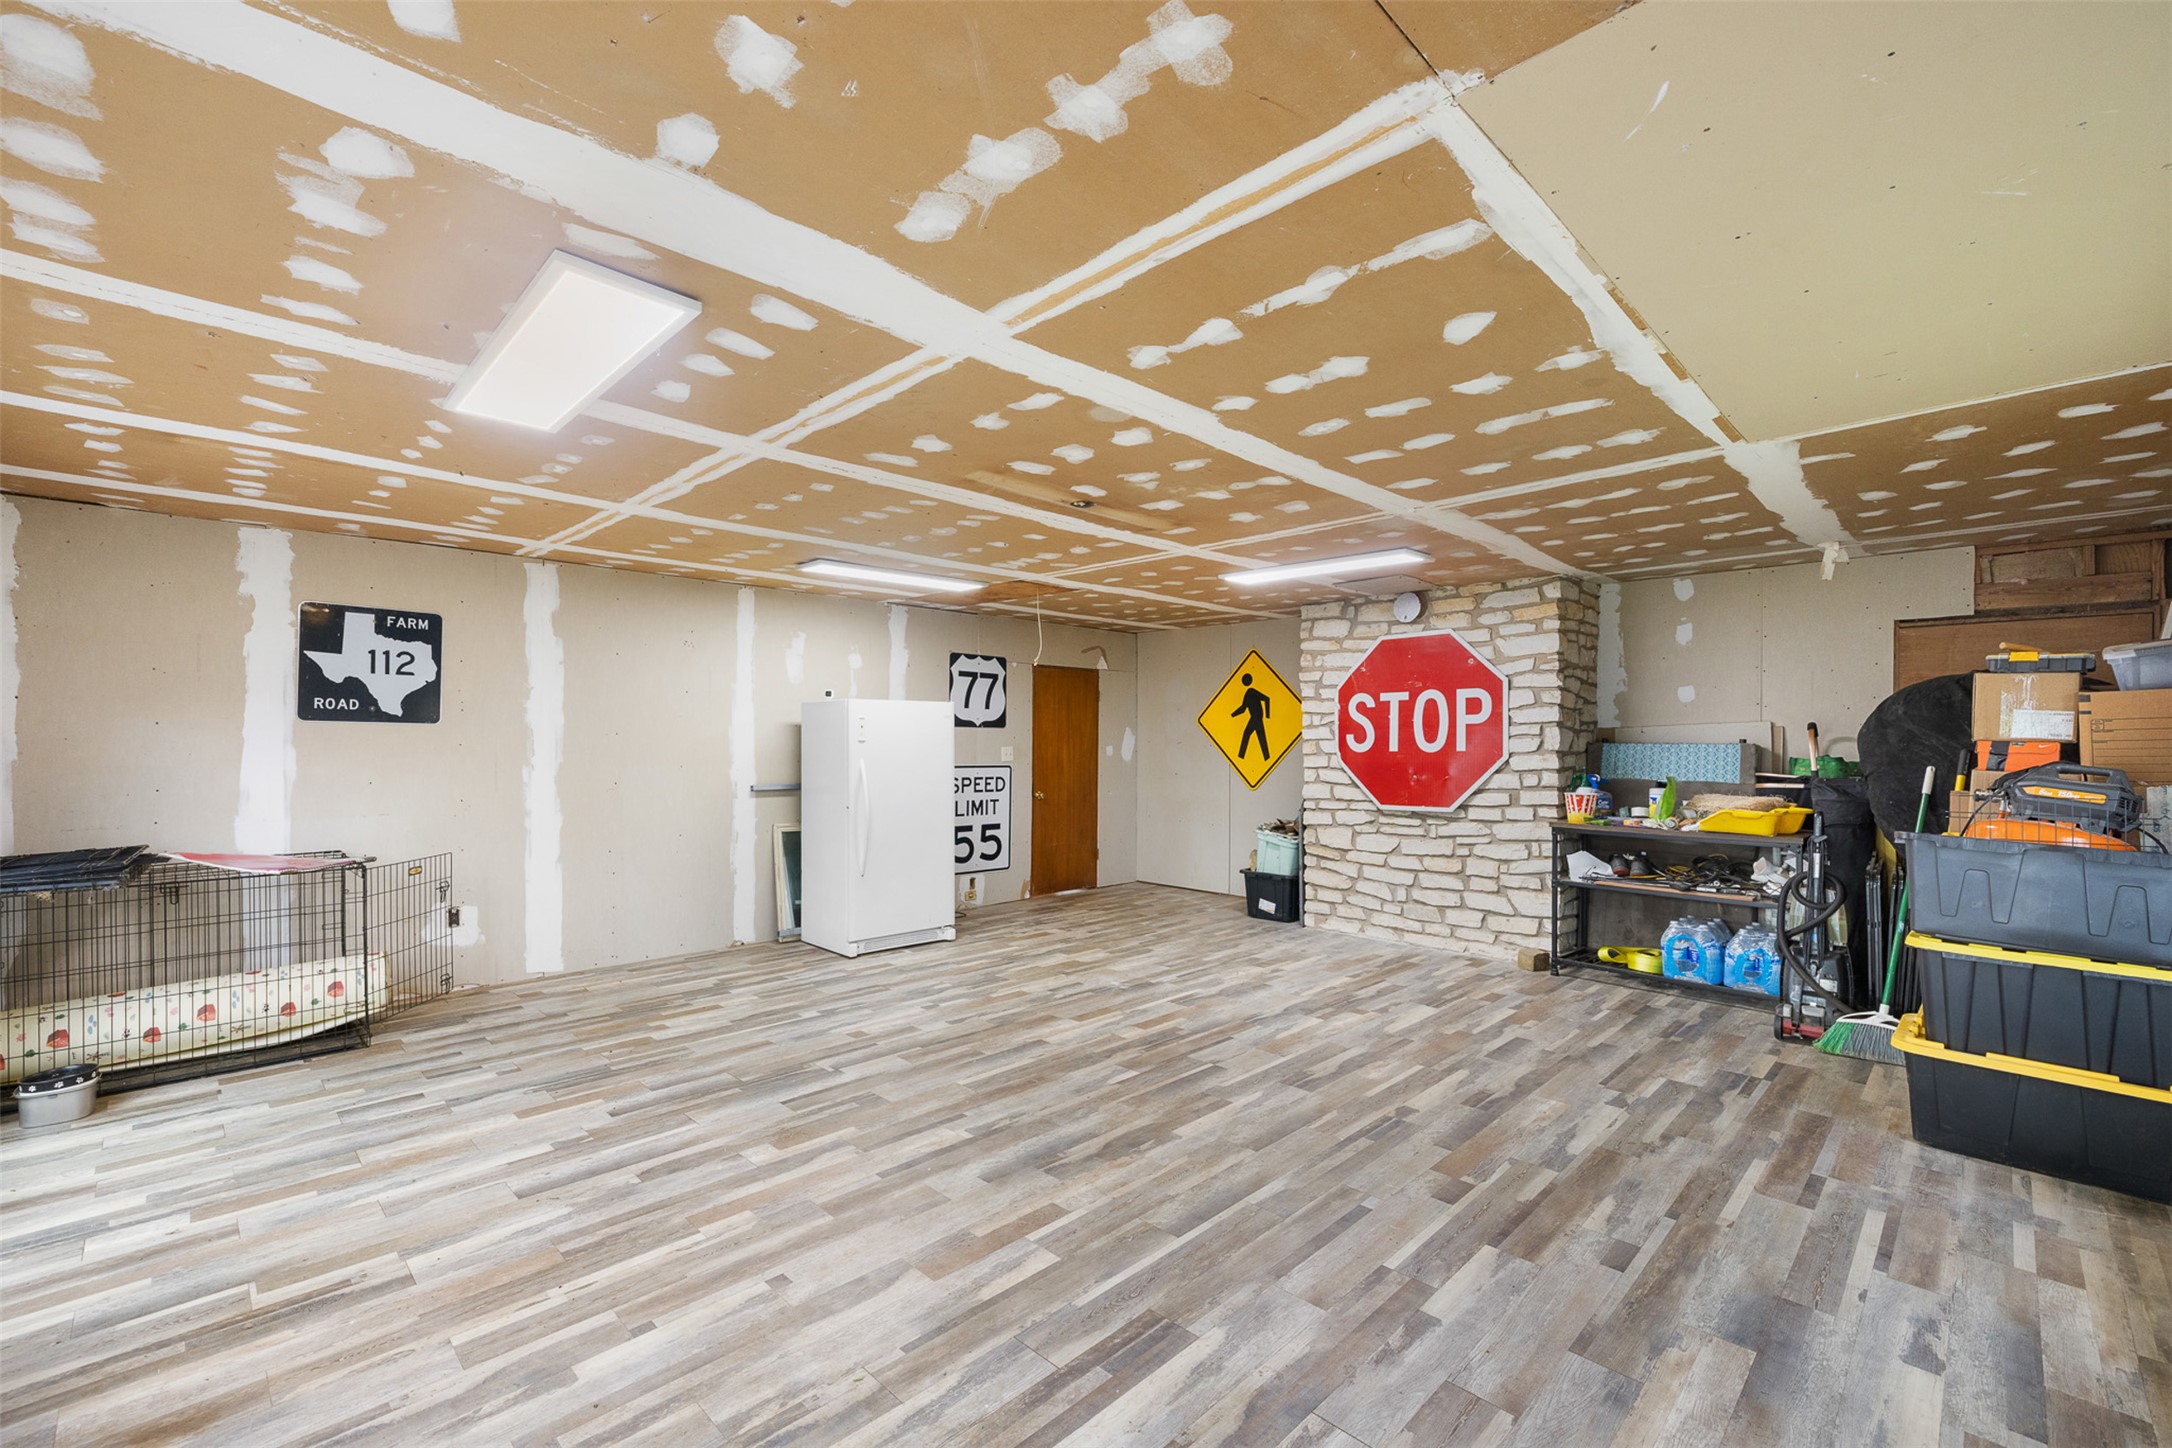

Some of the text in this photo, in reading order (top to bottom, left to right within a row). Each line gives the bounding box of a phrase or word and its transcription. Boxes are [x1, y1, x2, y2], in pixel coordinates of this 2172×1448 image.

[387, 616, 429, 631] FARM
[368, 649, 415, 676] 112
[958, 670, 999, 710] 77
[313, 697, 360, 711] ROAD
[1345, 687, 1493, 754] STOP
[954, 798, 1000, 817] LIMIT
[954, 823, 1002, 864] 55
